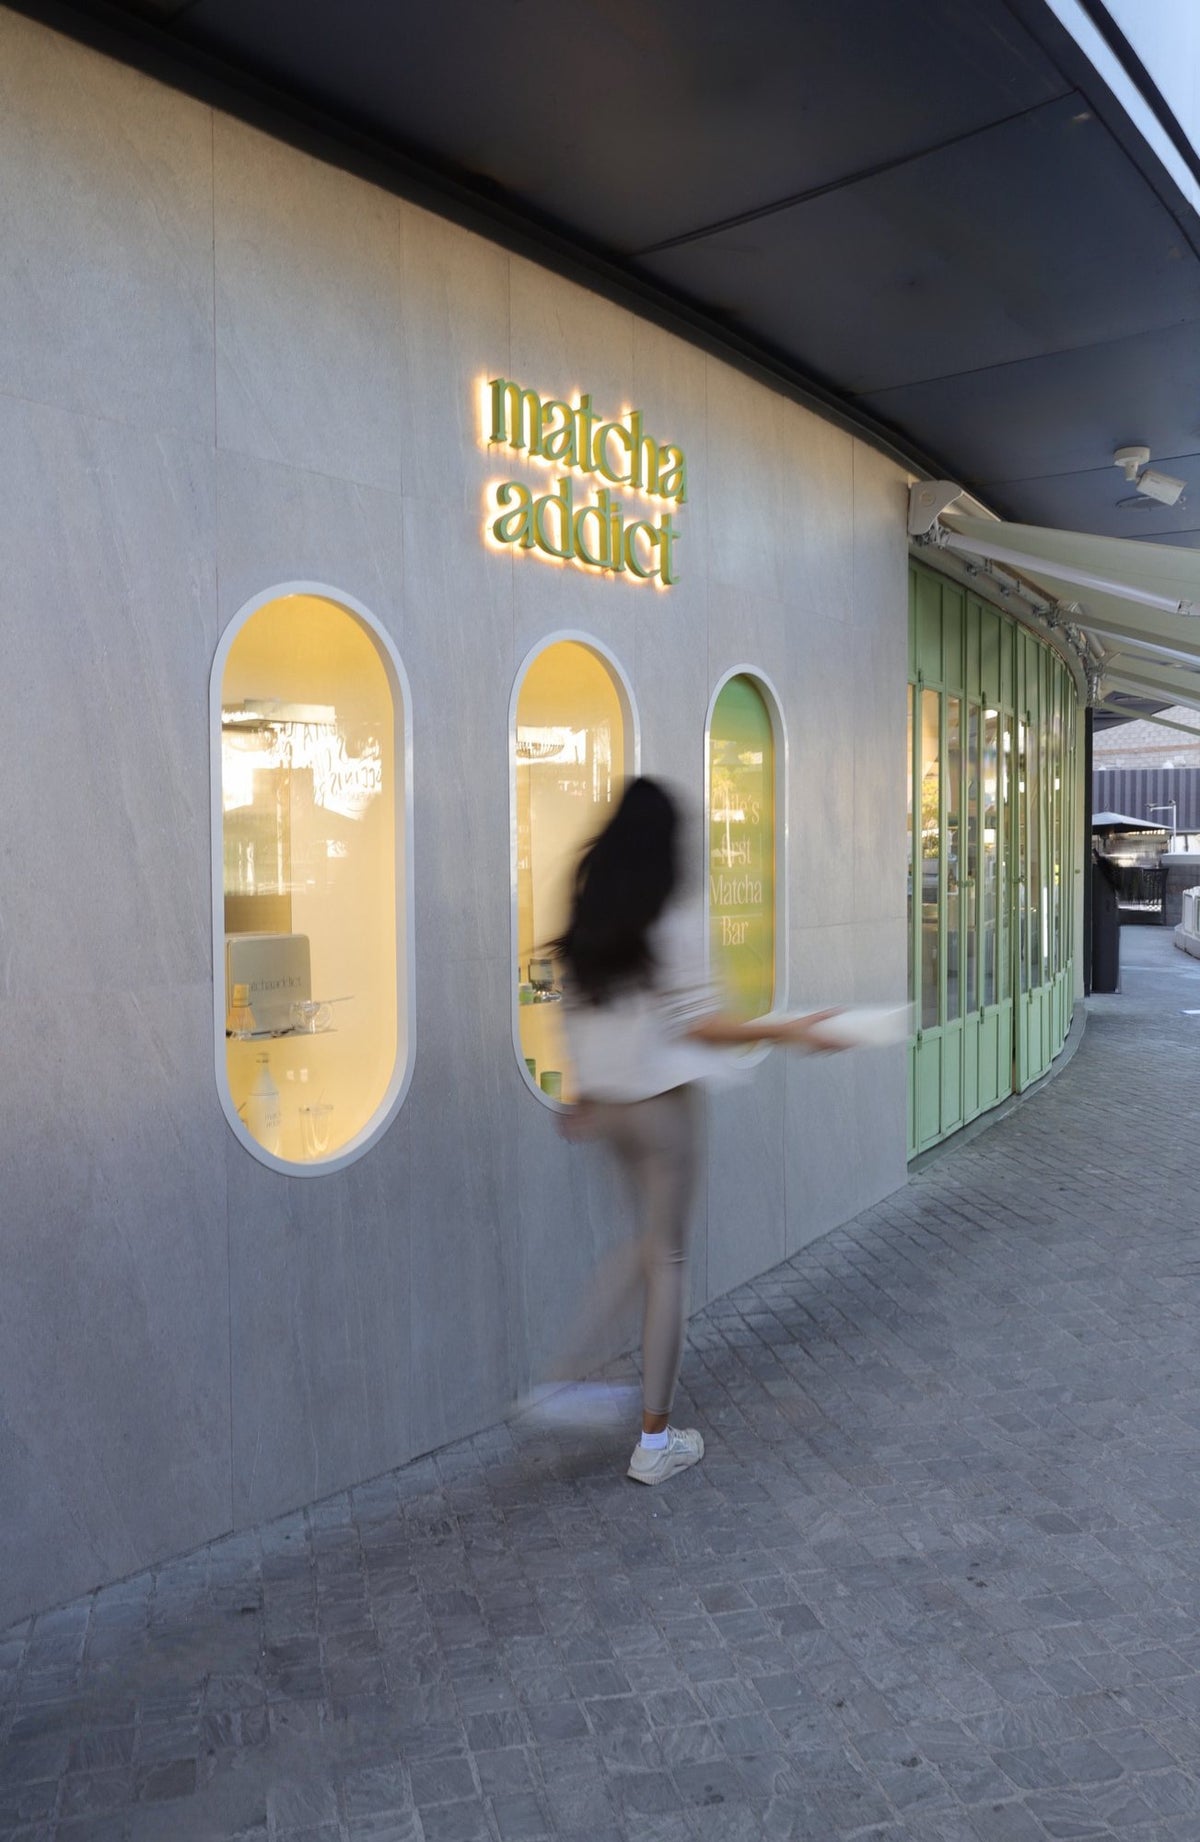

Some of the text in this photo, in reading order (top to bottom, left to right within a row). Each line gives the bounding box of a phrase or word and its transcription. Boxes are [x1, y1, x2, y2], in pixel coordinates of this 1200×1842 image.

[488, 377, 687, 504] matcha
[492, 476, 681, 585] addict
[709, 874, 763, 906] Matcha
[720, 915, 749, 946] Bar
